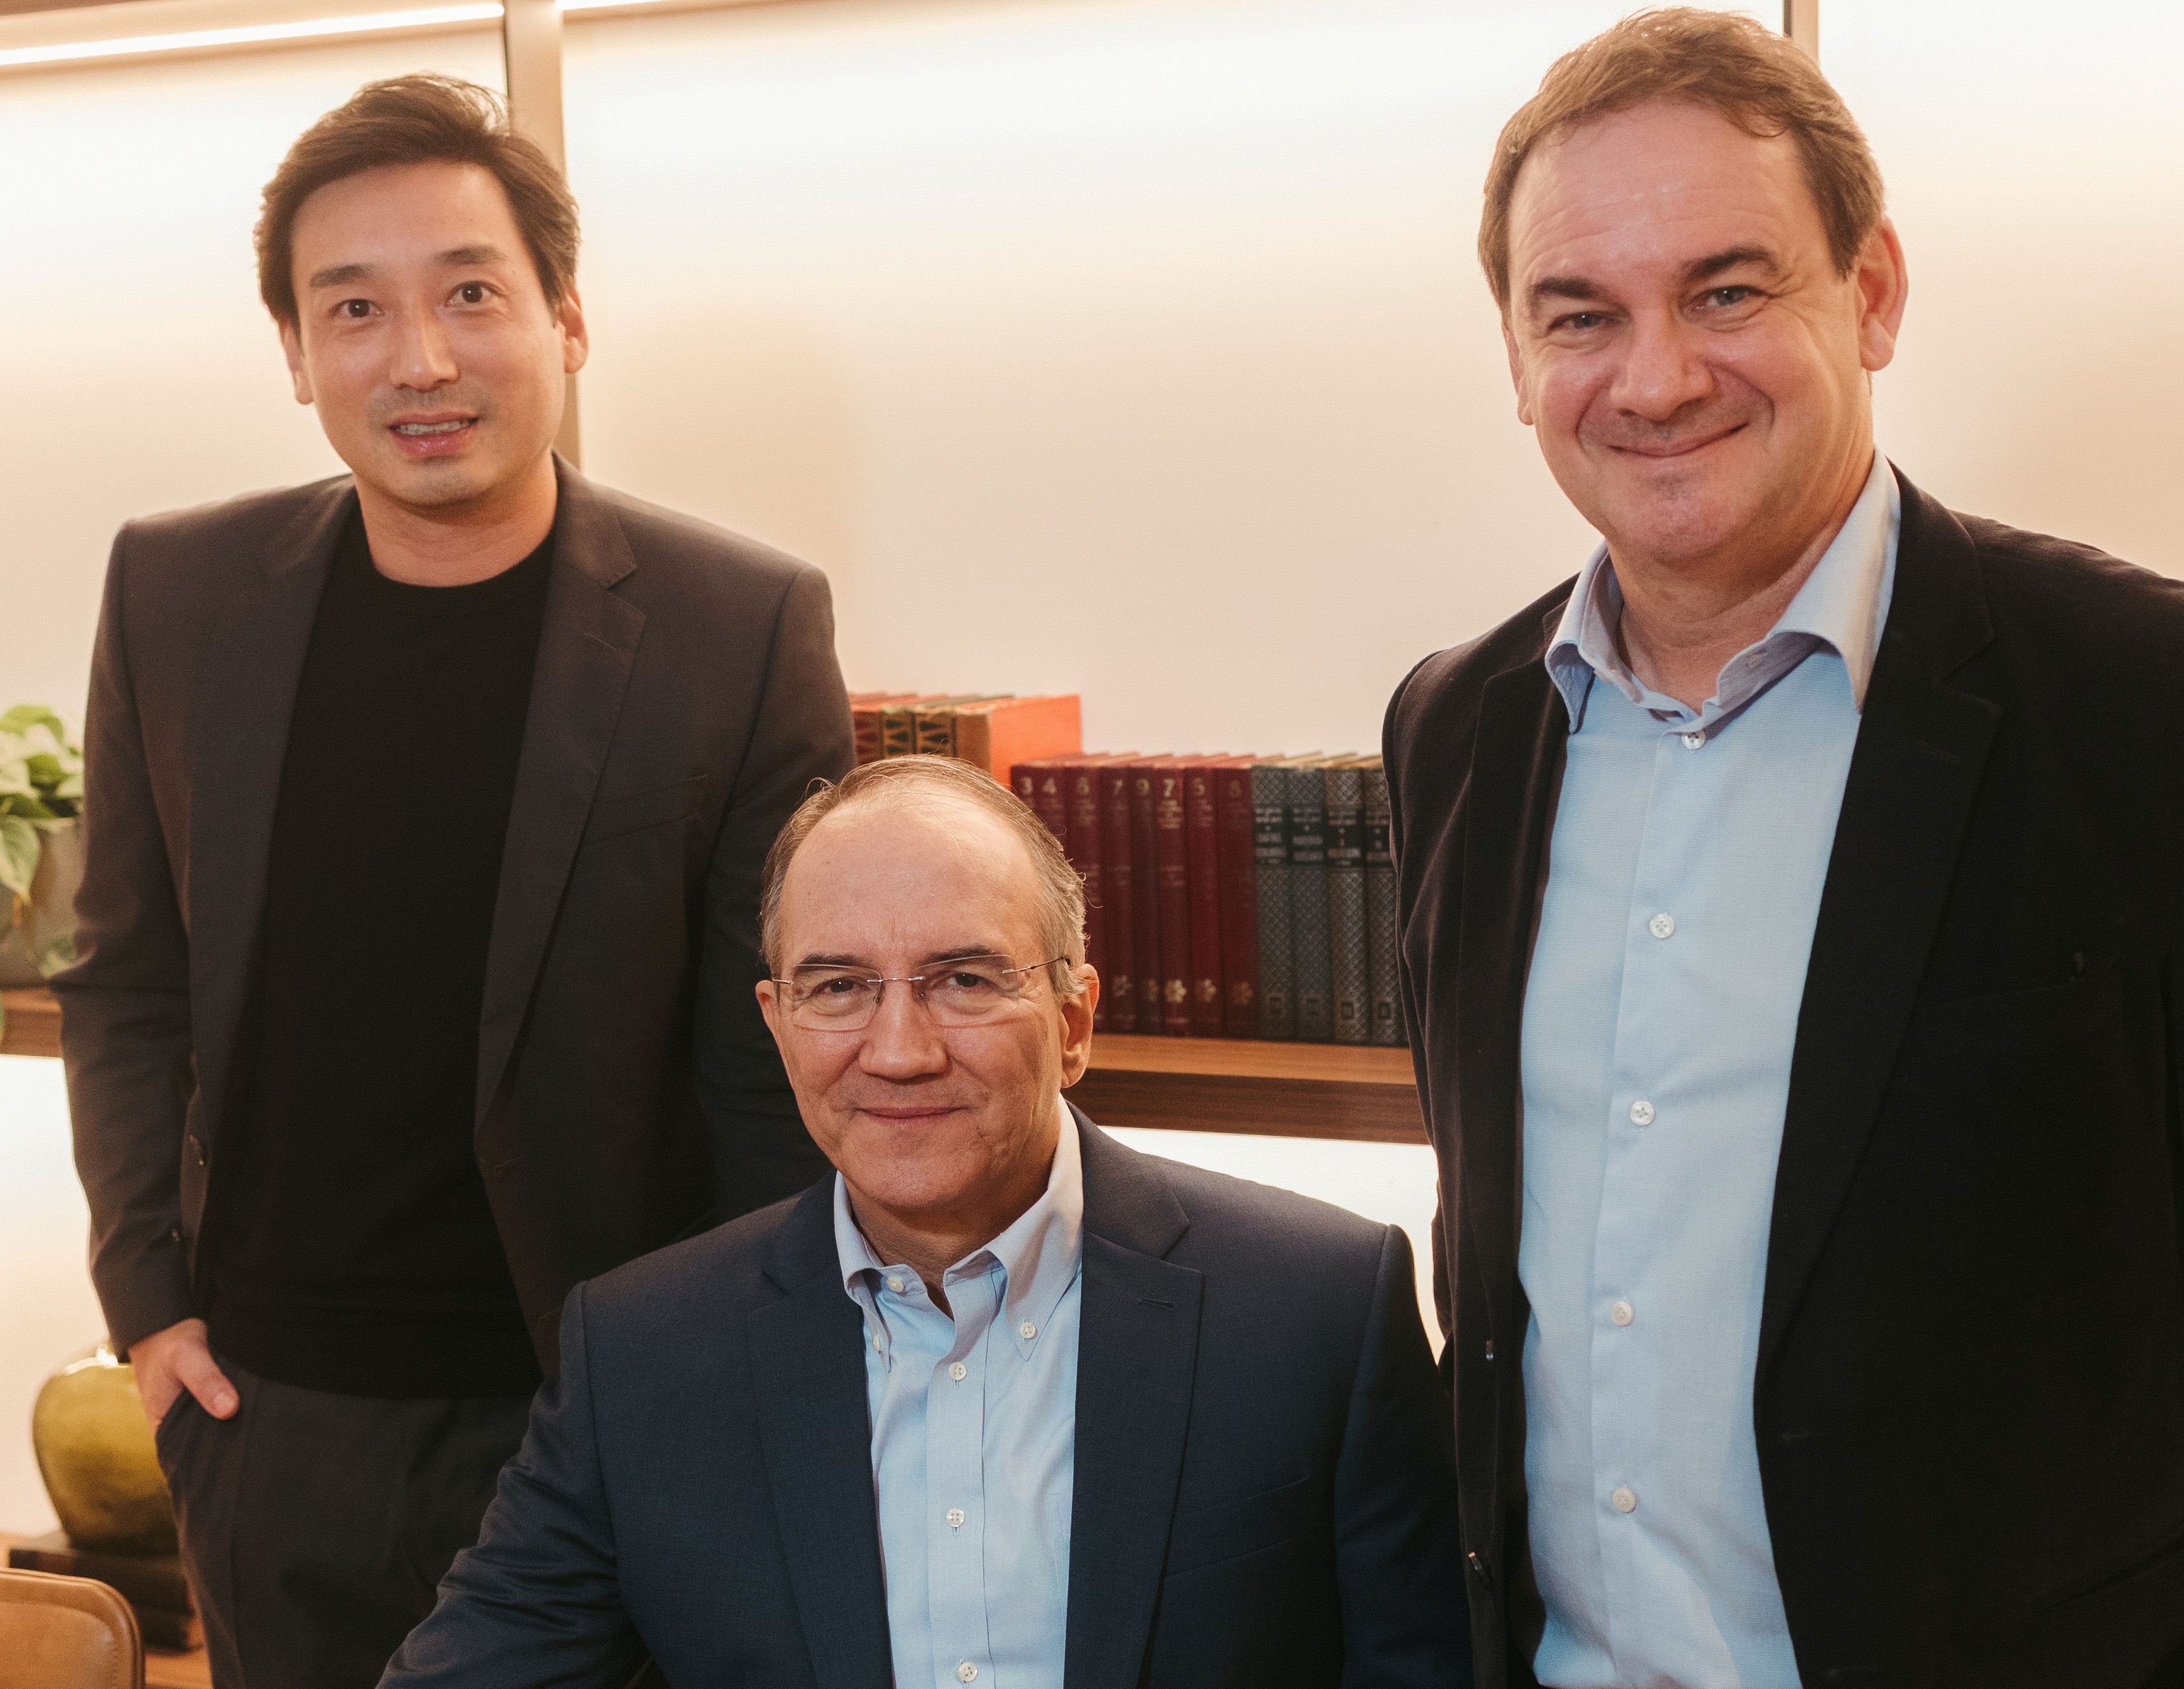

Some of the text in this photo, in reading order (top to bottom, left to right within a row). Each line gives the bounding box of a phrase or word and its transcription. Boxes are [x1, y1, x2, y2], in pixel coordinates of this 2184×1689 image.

[1020, 776, 1033, 795] 3
[1042, 778, 1057, 795] 4
[1113, 778, 1123, 795] 7
[1163, 778, 1175, 798] 7
